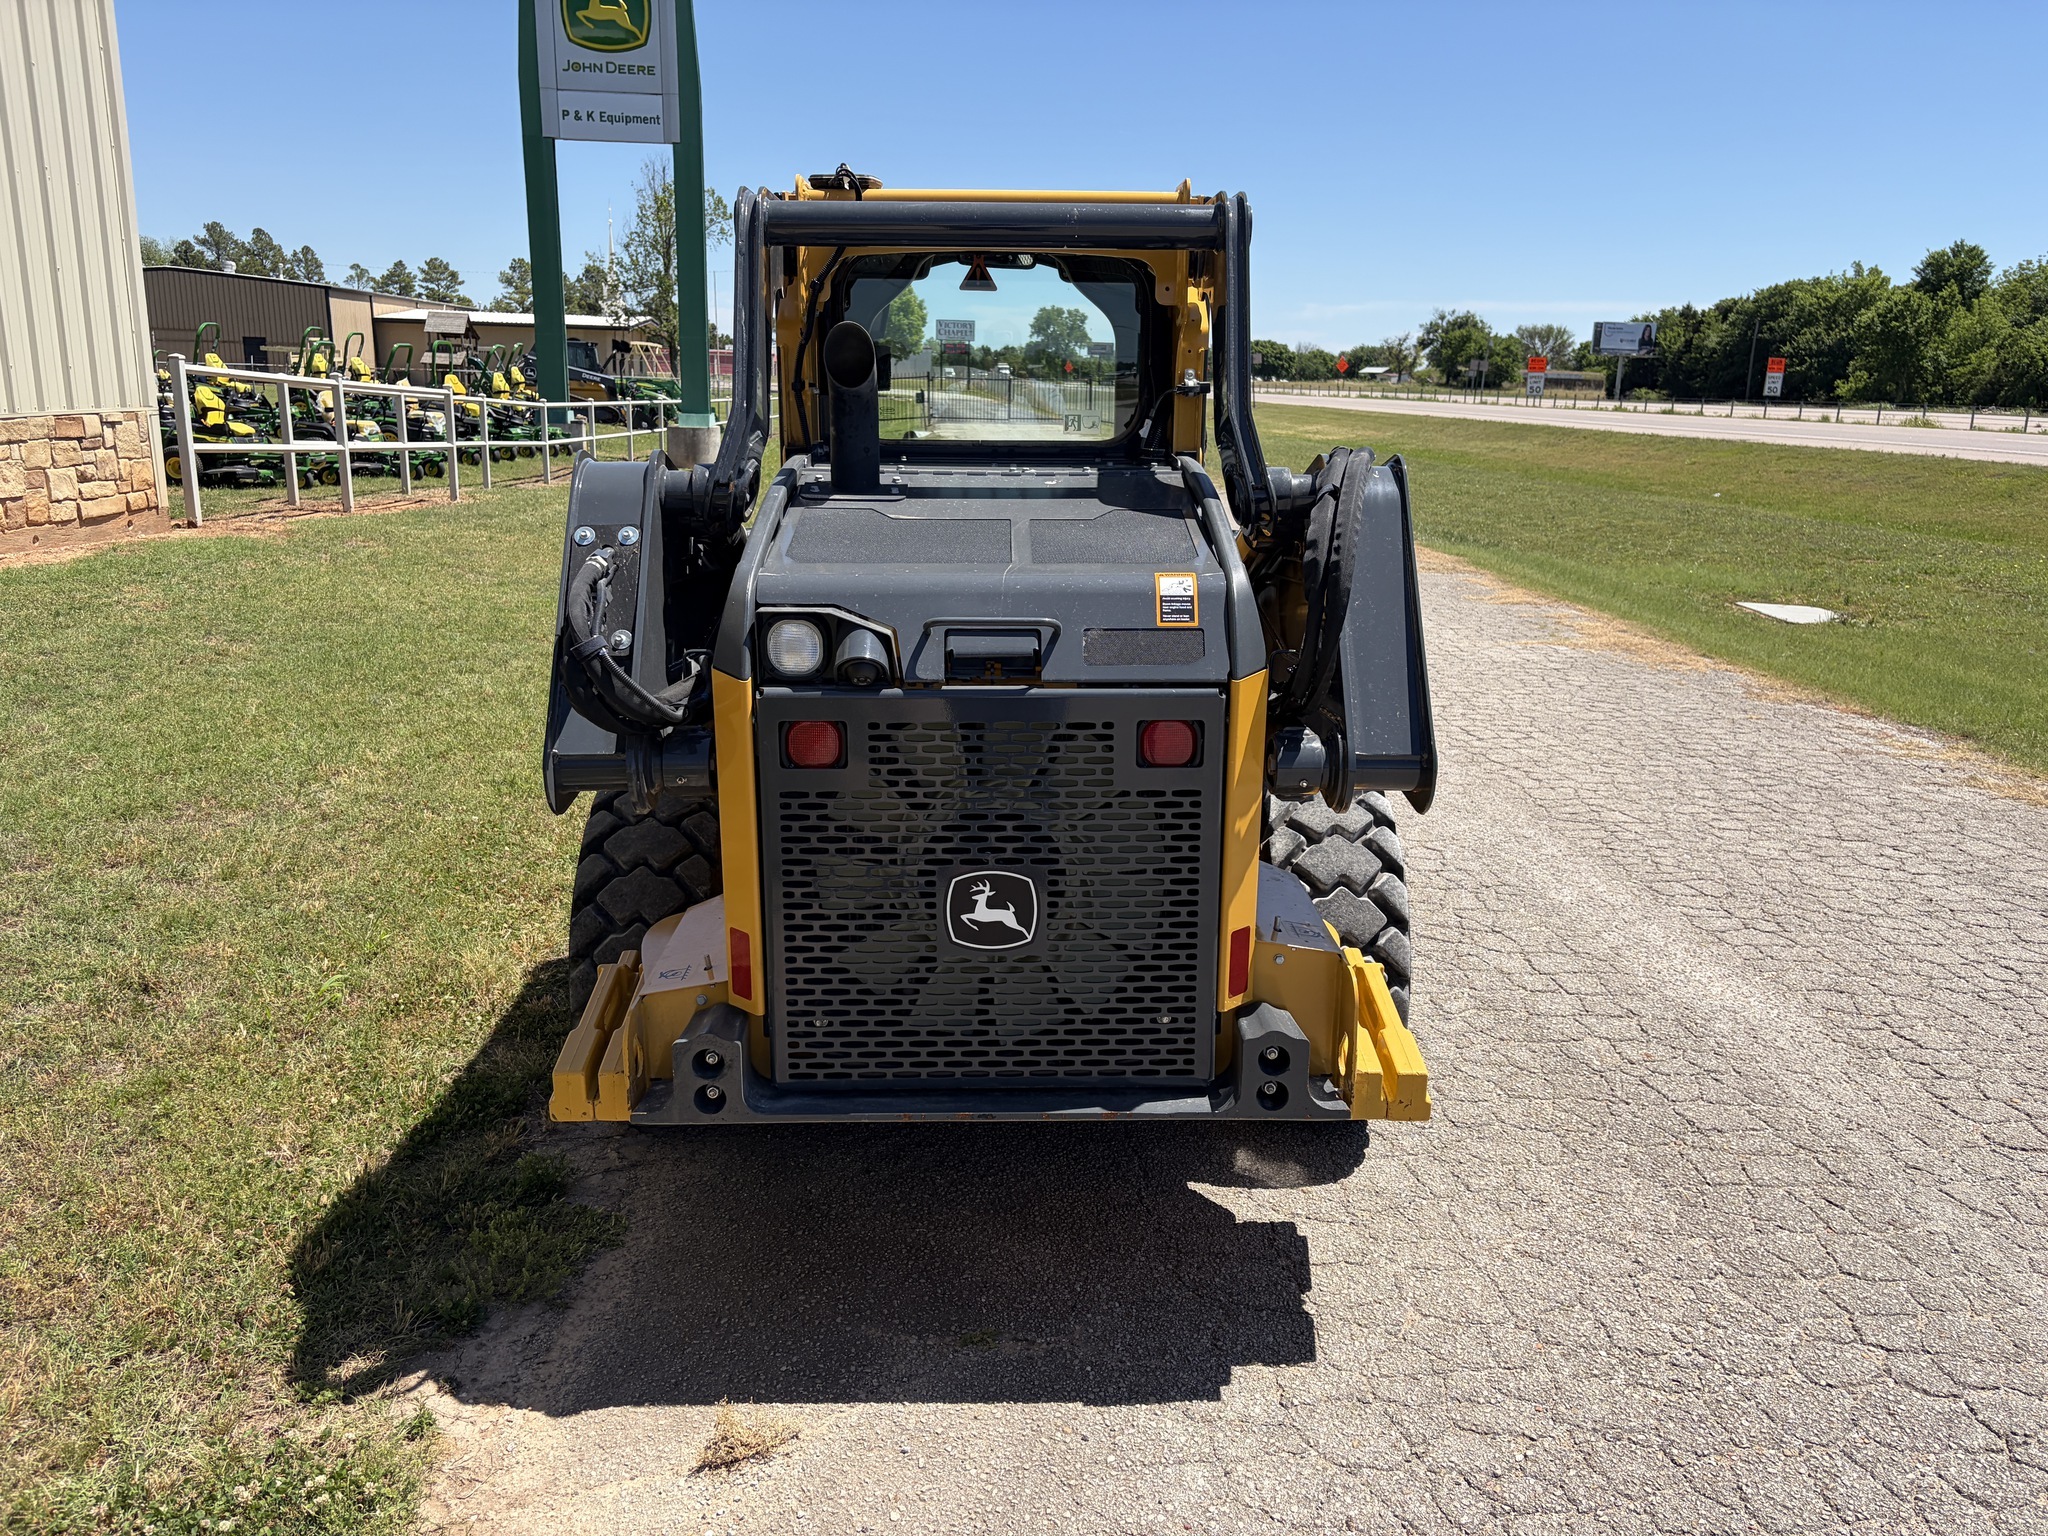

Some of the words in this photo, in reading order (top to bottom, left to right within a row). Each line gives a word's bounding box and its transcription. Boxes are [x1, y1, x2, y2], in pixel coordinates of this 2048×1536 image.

[562, 59, 603, 73] JOHN
[605, 61, 656, 76] DEERE
[562, 109, 570, 120] P
[573, 110, 582, 121] &
[586, 110, 595, 122] K
[599, 111, 661, 126] Equipment
[938, 320, 973, 330] VICTORY
[581, 372, 601, 381] DEERE
[1529, 385, 1541, 394] 50
[1766, 385, 1778, 394] 50
